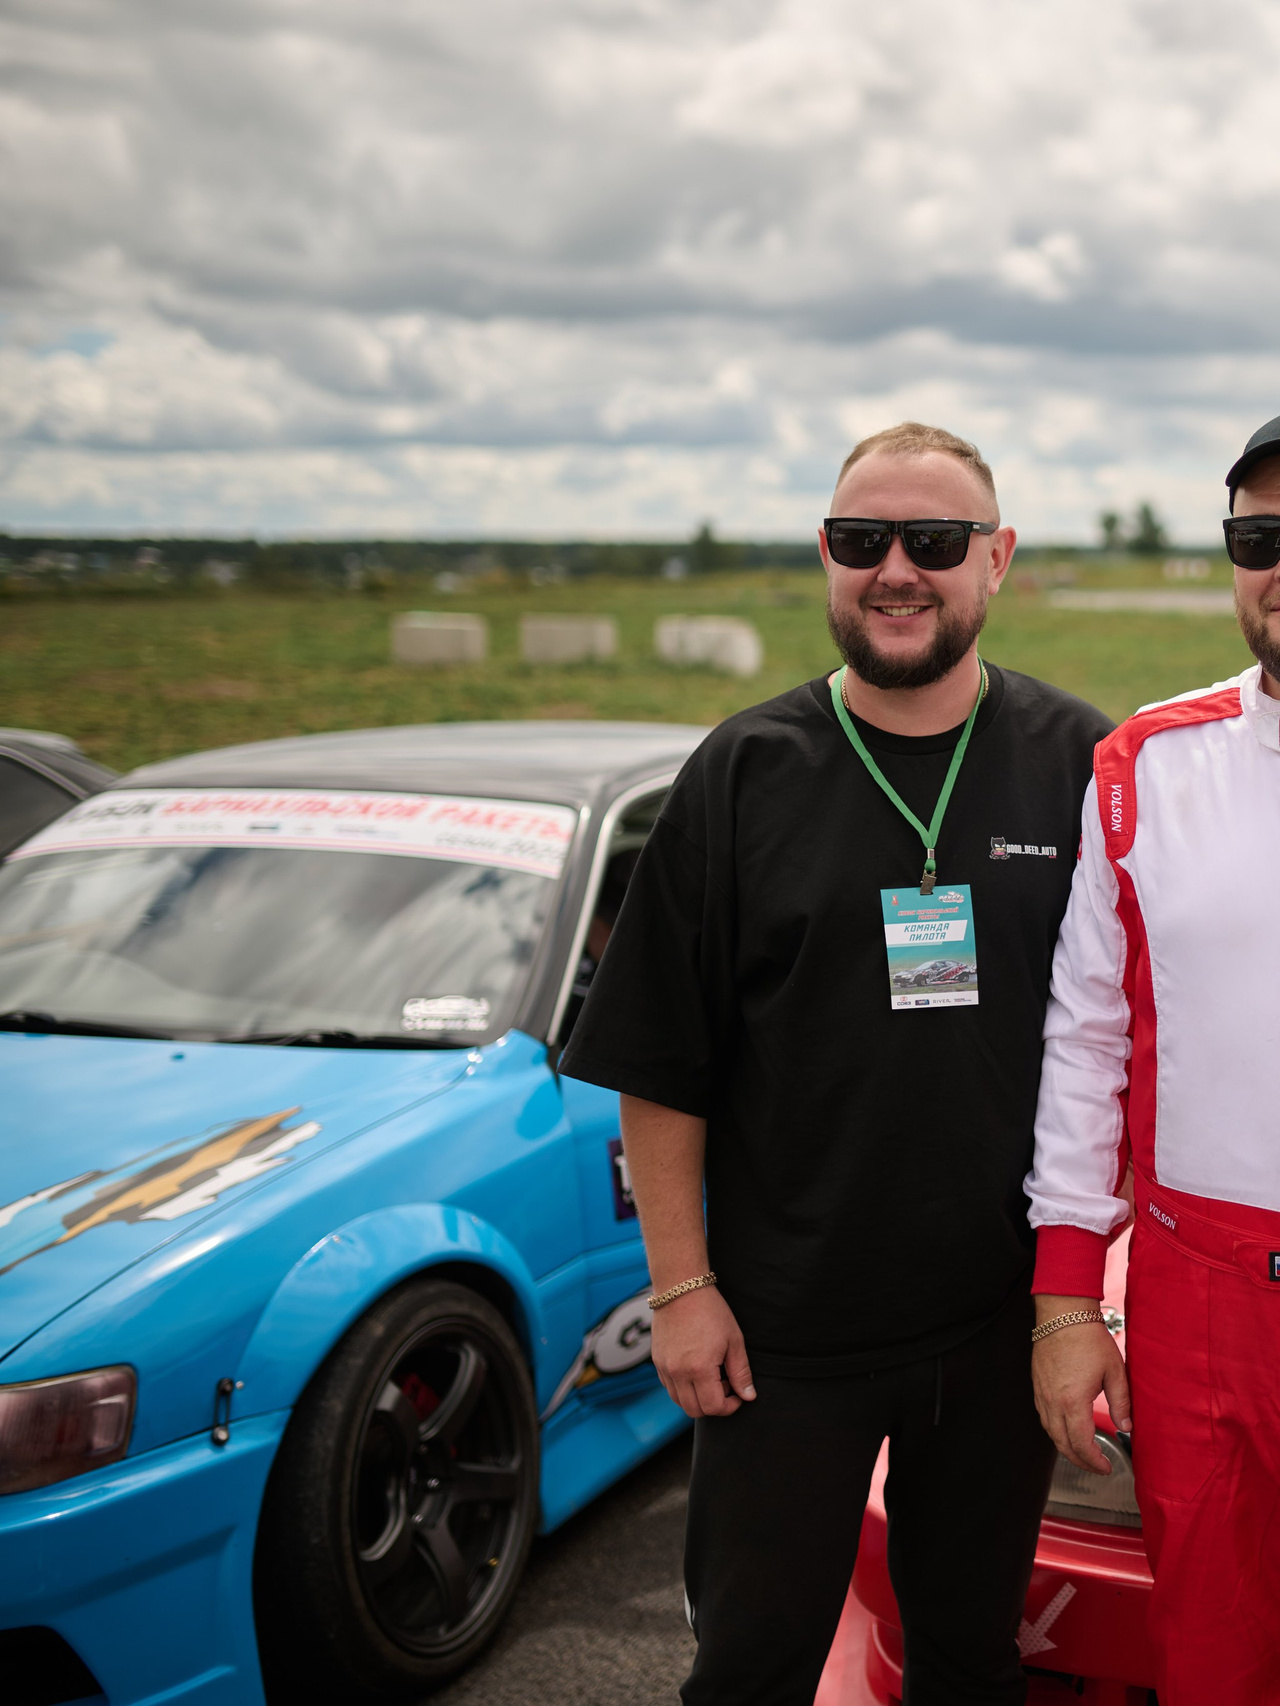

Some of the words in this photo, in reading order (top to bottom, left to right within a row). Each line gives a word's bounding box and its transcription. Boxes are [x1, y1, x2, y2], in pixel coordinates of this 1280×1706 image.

[1111, 784, 1122, 832] VOLSON
[904, 922, 950, 933] КОМАНДА
[909, 932, 947, 941] ПИЛОТА
[1149, 1202, 1176, 1230] VOLSON
